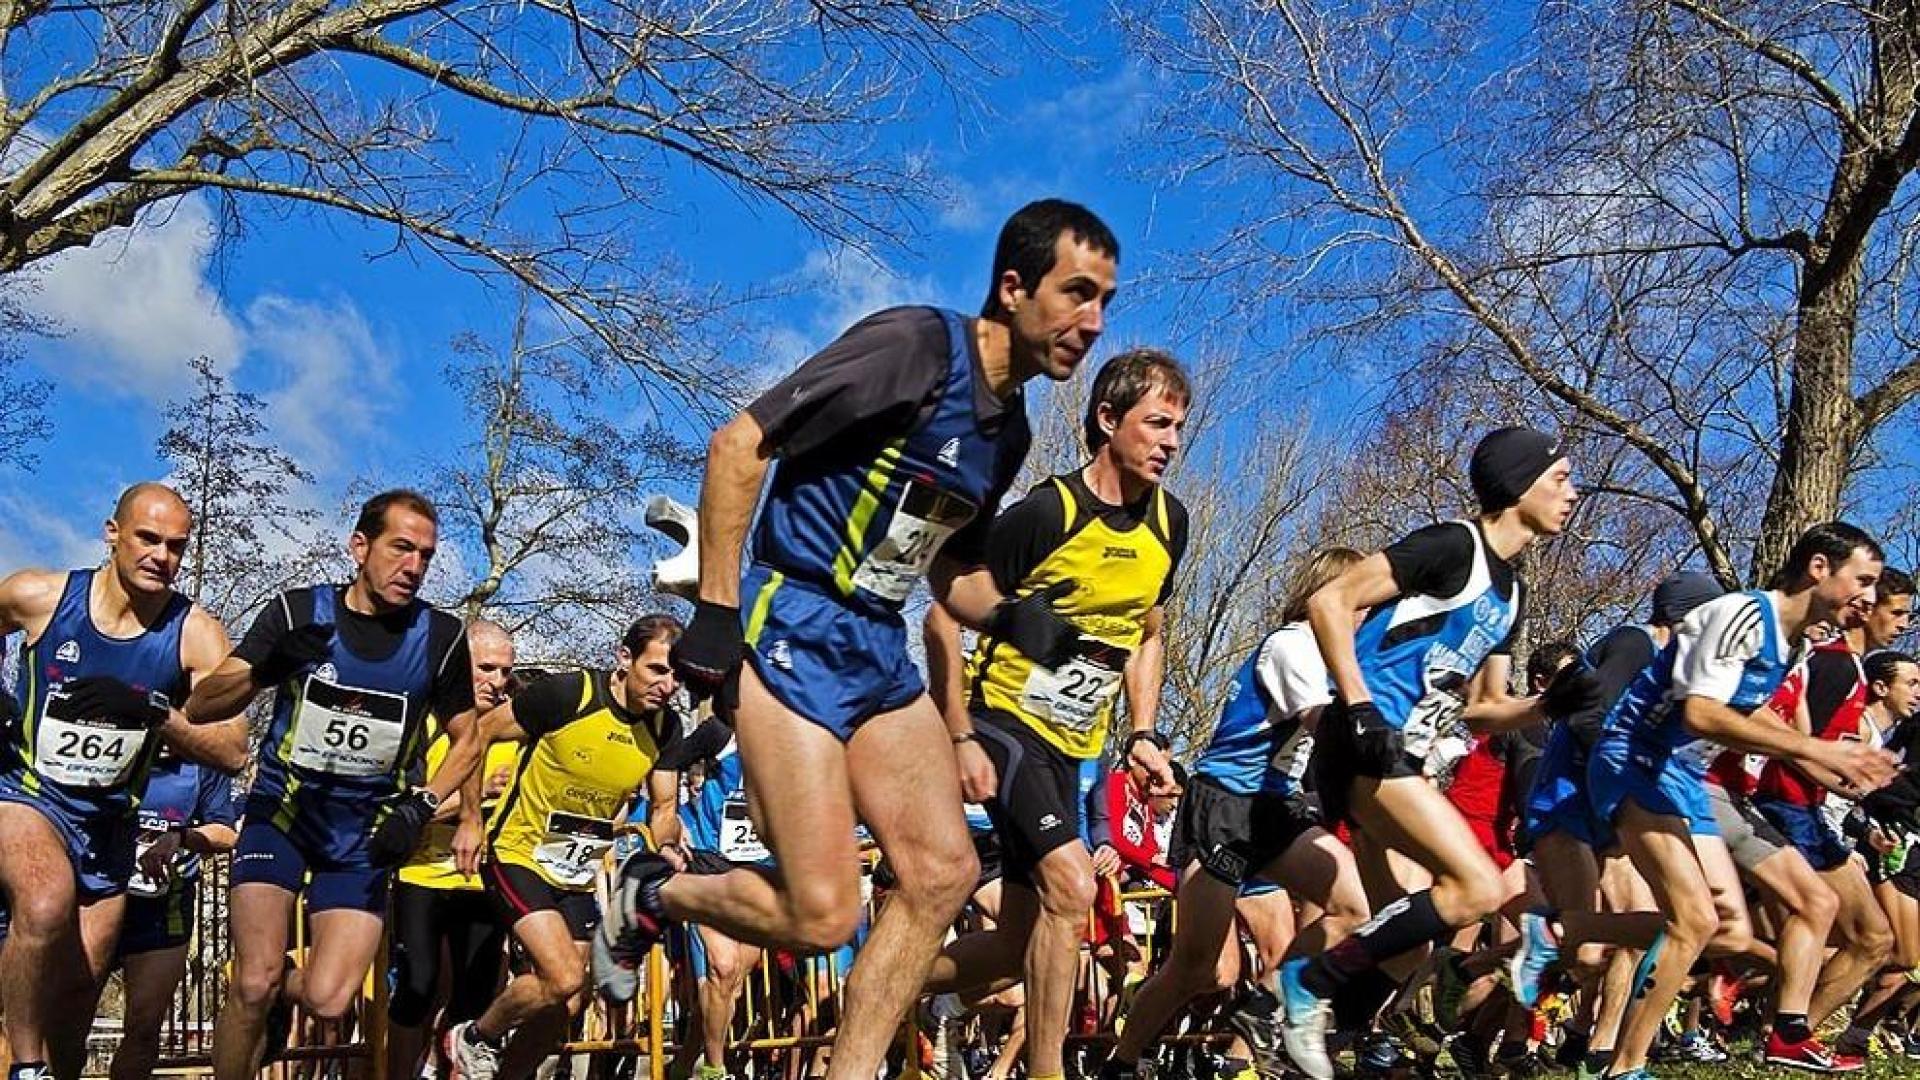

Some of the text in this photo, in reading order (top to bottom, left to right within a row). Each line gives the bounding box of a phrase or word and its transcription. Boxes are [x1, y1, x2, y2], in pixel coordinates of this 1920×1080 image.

[1059, 669, 1104, 704] 22
[56, 730, 125, 761] 264
[323, 719, 369, 751] 56
